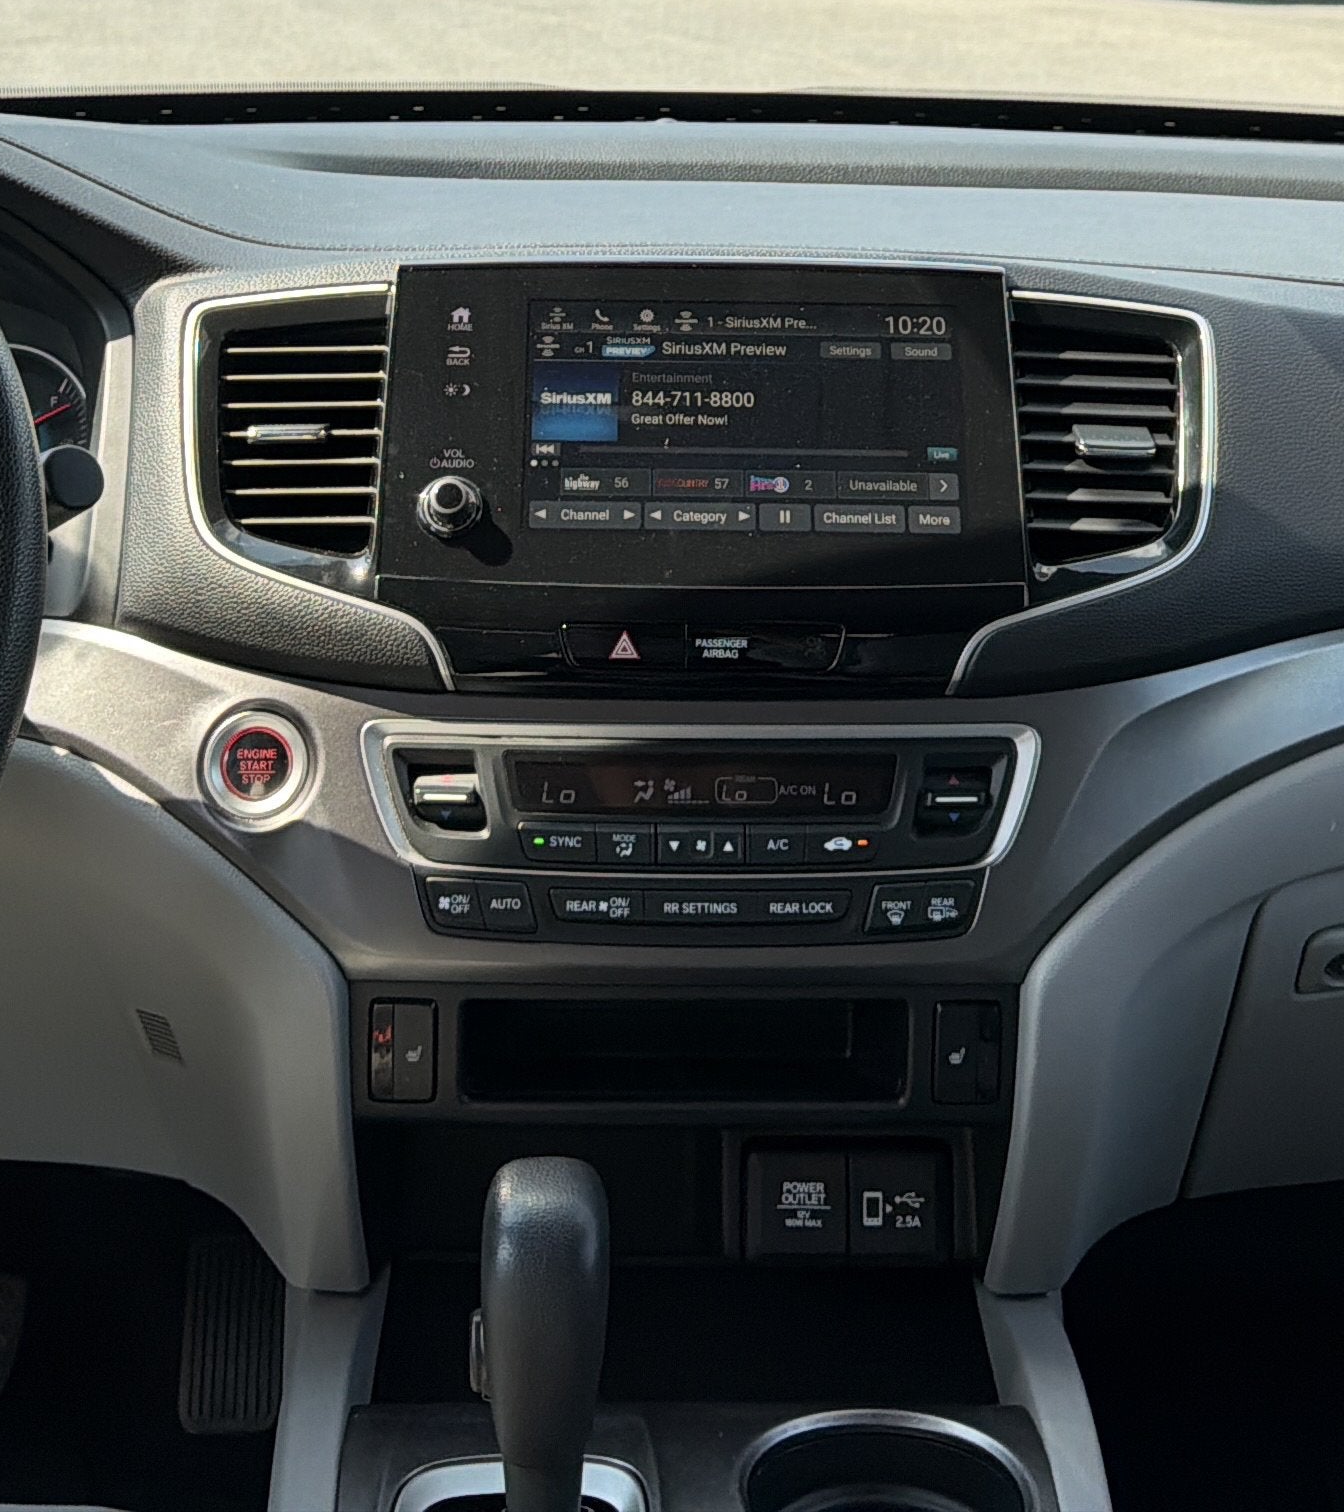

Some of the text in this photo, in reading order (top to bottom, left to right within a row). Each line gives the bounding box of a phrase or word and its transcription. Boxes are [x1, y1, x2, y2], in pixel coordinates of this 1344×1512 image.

[633, 324, 661, 332] Settings
[724, 316, 781, 329] SiriusXM
[784, 317, 817, 329] Pre...
[885, 316, 946, 335] 10:20
[606, 336, 651, 345] SIRIUSXM
[606, 347, 650, 356] PREVIEW
[662, 342, 787, 356] SiriusXM Preview
[829, 346, 872, 358] Settings
[904, 347, 938, 356] Sound
[446, 358, 470, 366] BACK
[632, 373, 713, 384] Entertainment
[50, 396, 58, 407] F
[540, 392, 612, 405] SiriusXM
[632, 391, 755, 408] 844-711-8800
[631, 413, 729, 426] Great Offer Now!
[443, 449, 465, 458] VOL
[934, 451, 949, 459] Live
[441, 459, 475, 468] AUDIO
[564, 477, 600, 491] highway
[614, 477, 629, 488] 56
[714, 478, 729, 489] 57
[805, 480, 813, 491] 2
[849, 479, 918, 491] Unavailable
[561, 509, 609, 521] Channel
[673, 510, 727, 524] Category
[823, 512, 897, 525] Channel List
[919, 514, 950, 526] More
[695, 638, 748, 648] PASSENGER
[702, 649, 739, 659] AIRBAG
[237, 748, 277, 759] ENGINE
[240, 760, 274, 771] START
[242, 774, 271, 784] STOP
[541, 781, 576, 804] Lo
[722, 784, 748, 802] Lo
[779, 785, 816, 796] A/C ON
[823, 782, 856, 806] Lo
[549, 836, 582, 848] SYNC
[613, 834, 636, 843] MODE
[767, 839, 789, 851] A/C
[451, 894, 471, 904] ON/
[490, 898, 521, 910] AUTO
[609, 897, 630, 907] ON/
[931, 898, 955, 907] REAR
[451, 904, 470, 914] OFF
[566, 901, 596, 912] REAR
[663, 902, 738, 915] RR SETTINGS
[769, 902, 834, 914] REAR LOCK
[881, 900, 912, 911] FRONT
[609, 907, 631, 918] OFF
[783, 1181, 825, 1193] POWER
[781, 1193, 826, 1204] OUTLET
[797, 1210, 810, 1219] 12V
[805, 1219, 823, 1227] MAX
[895, 1215, 922, 1228] 2.5A
